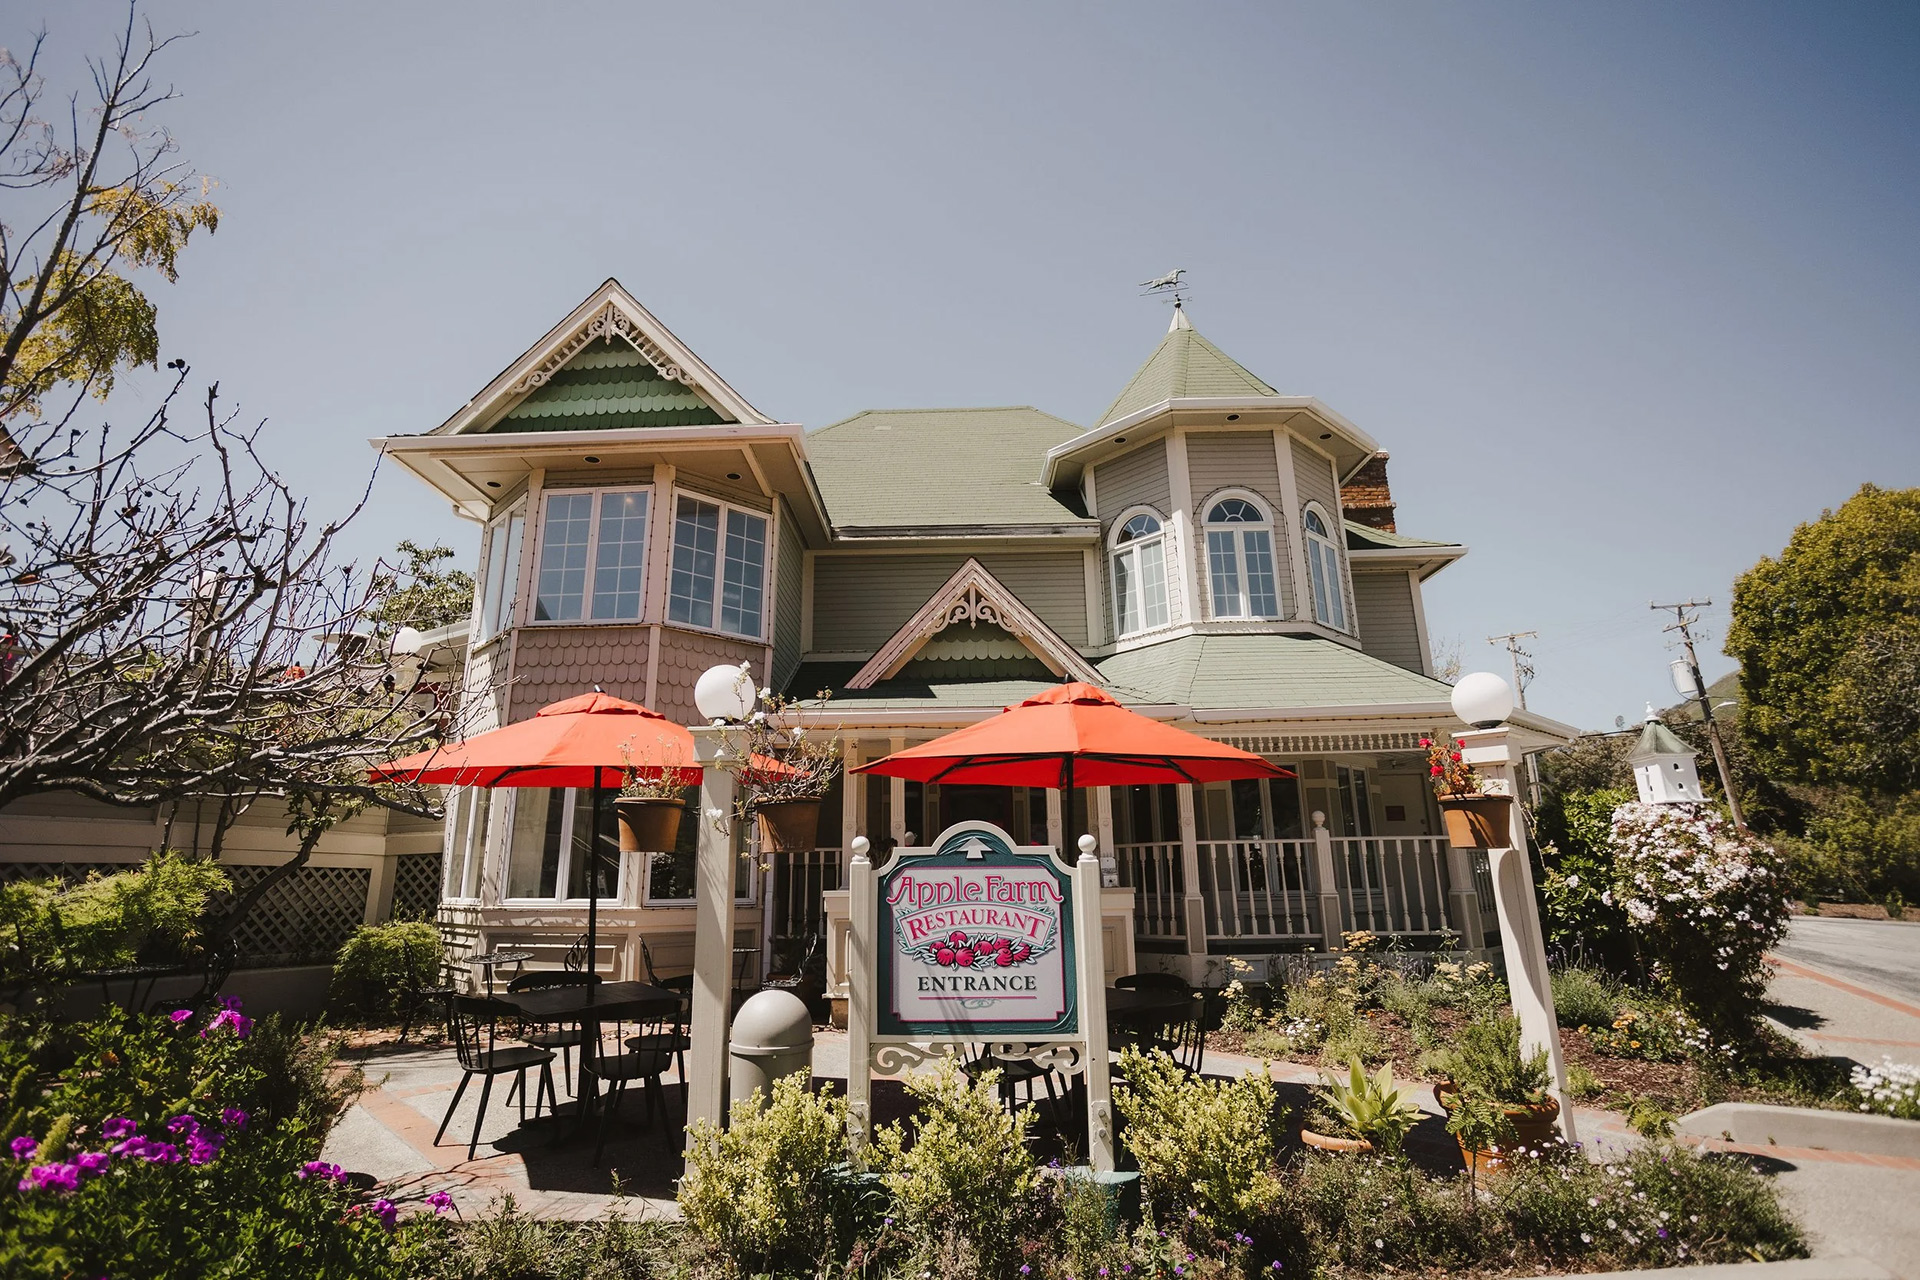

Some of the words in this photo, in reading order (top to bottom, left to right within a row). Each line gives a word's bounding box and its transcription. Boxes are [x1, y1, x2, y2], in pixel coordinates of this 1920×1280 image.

[887, 876, 980, 909] Apple
[984, 876, 1064, 903] Farm
[907, 908, 1045, 940] RESTAURANT
[917, 975, 1037, 992] ENTRANCE
